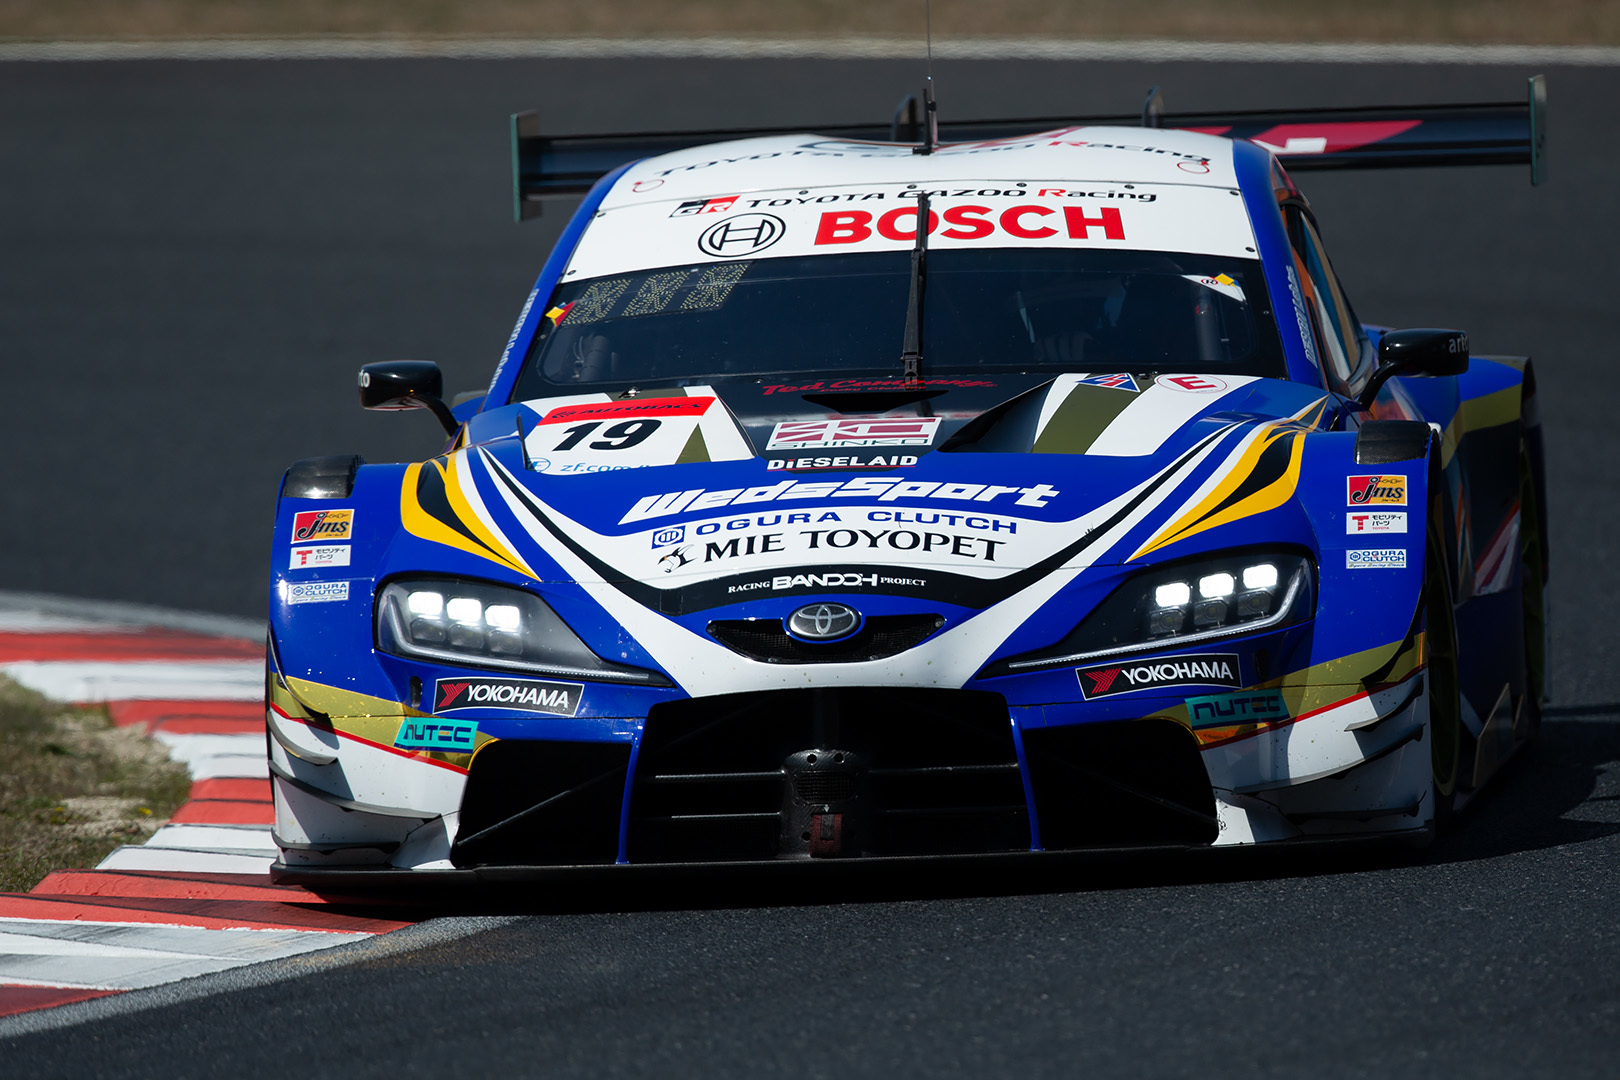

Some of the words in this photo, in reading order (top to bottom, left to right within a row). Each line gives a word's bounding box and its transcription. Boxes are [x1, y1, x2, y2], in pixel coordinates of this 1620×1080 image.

[746, 192, 885, 209] TOYOTA
[897, 188, 1027, 199] GAZOO
[1037, 188, 1157, 203] Racing
[814, 205, 1127, 246] BOSCH
[763, 381, 826, 396] Ted
[1166, 376, 1217, 390] E
[552, 419, 662, 451] 19
[773, 439, 928, 448] SHINKO
[617, 477, 1060, 525] WedsSport
[695, 511, 842, 536] OGURA
[867, 511, 1017, 534] CLUTCH
[704, 533, 787, 563] MIE
[799, 529, 1008, 562] TOYOPET
[728, 580, 771, 593] RACING
[772, 573, 878, 590] BANDOH
[880, 576, 926, 587] PROJECT
[1121, 661, 1234, 685] YOKOHAMA
[467, 684, 569, 708] YOKOHAMA
